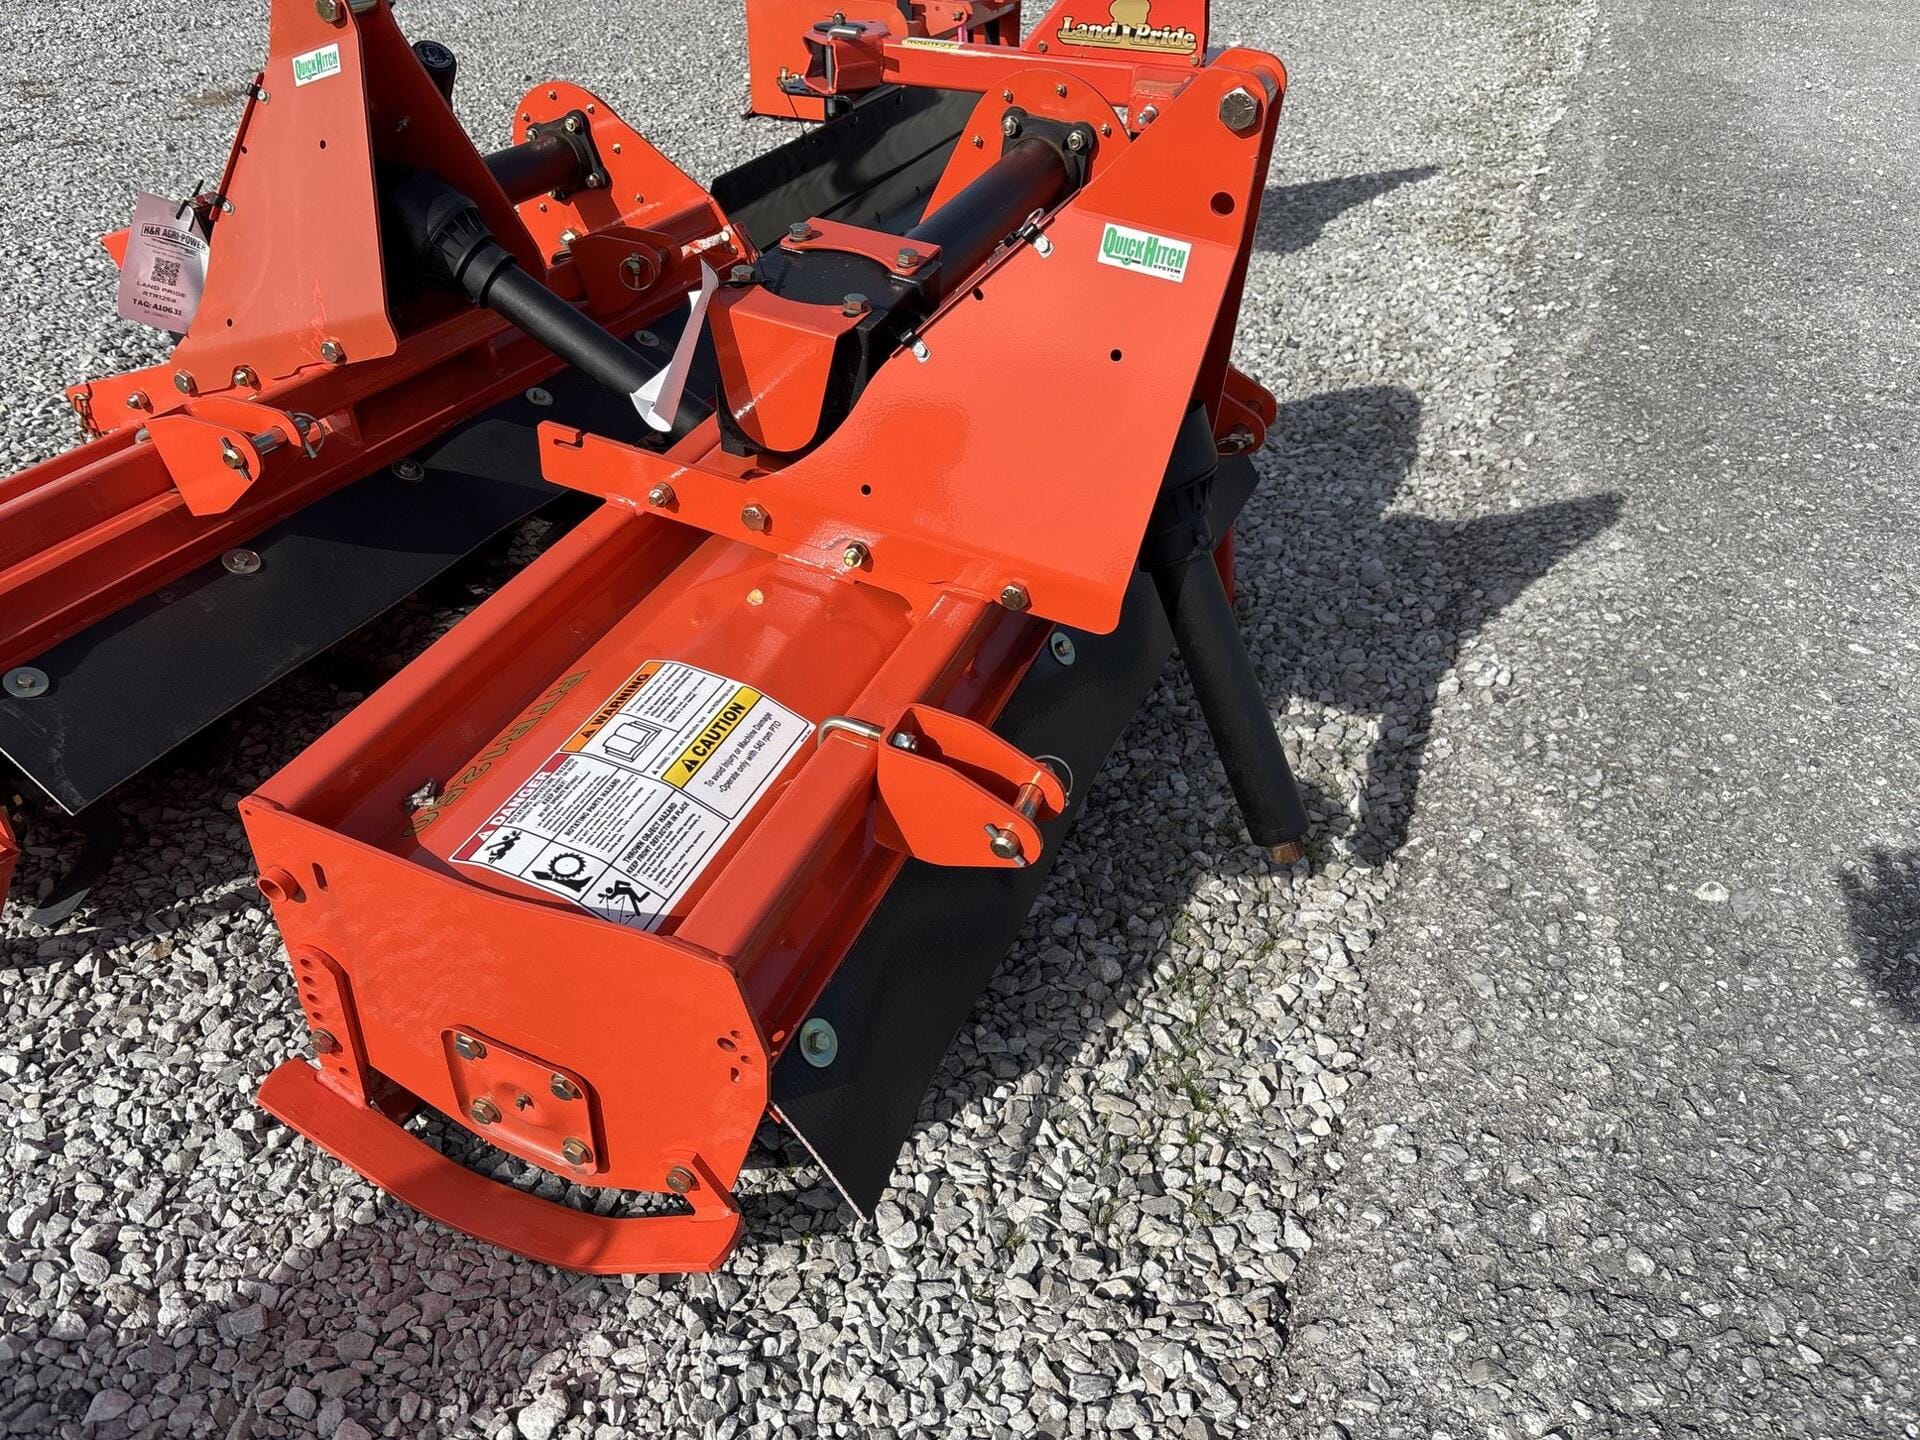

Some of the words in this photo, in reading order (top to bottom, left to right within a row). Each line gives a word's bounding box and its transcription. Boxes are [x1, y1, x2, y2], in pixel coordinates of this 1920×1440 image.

[1060, 16, 1118, 40] Land
[1131, 23, 1196, 47] Pride
[143, 225, 161, 236] H&R
[161, 228, 207, 252] AGRI-POWER
[136, 280, 160, 291] LAND
[161, 287, 187, 298] PRIDE
[1153, 264, 1181, 274] SYSTEM
[132, 298, 151, 309] TAG:
[592, 673, 650, 724] WARNING
[692, 702, 746, 756] CAUTION
[703, 778, 715, 787] To
[709, 765, 726, 781] avoid
[720, 752, 739, 769] Injury
[737, 728, 757, 748] Machine
[752, 711, 774, 731] Damage
[736, 759, 751, 773] only
[744, 748, 758, 761] with
[752, 739, 765, 750] 540
[761, 730, 774, 742] rpm
[768, 719, 782, 732] PTO
[495, 772, 552, 824] DANGER
[564, 810, 590, 838] ROTATING
[587, 795, 604, 813] PARTS
[601, 777, 621, 798] HAZARD
[623, 839, 645, 865] THROWN
[641, 820, 661, 843] OBJECT
[657, 801, 678, 823] HAZARD
[625, 859, 640, 875] KEEP
[636, 844, 653, 862] FRONT
[649, 819, 674, 848] DEFLECTOR
[670, 814, 678, 822] IN
[675, 801, 690, 817] PLACE
